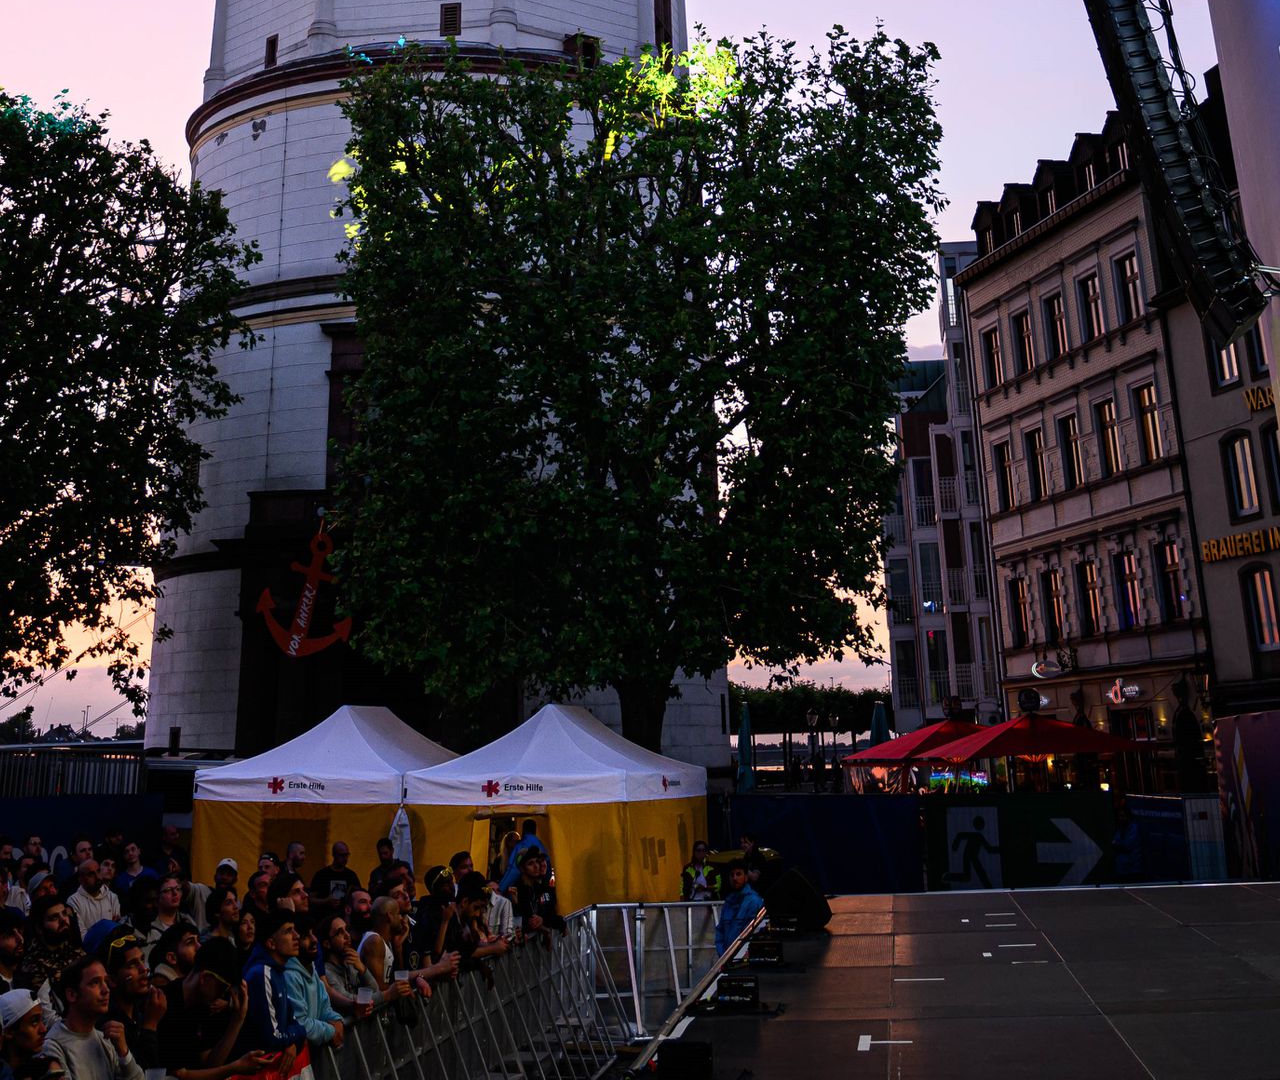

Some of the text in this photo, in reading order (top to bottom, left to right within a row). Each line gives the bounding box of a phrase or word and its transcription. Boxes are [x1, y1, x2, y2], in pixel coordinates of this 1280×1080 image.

[1201, 529, 1267, 564] BRAUEREI
[288, 781, 325, 791] Erste Hilfe
[503, 783, 544, 793] Erste Hilfe
